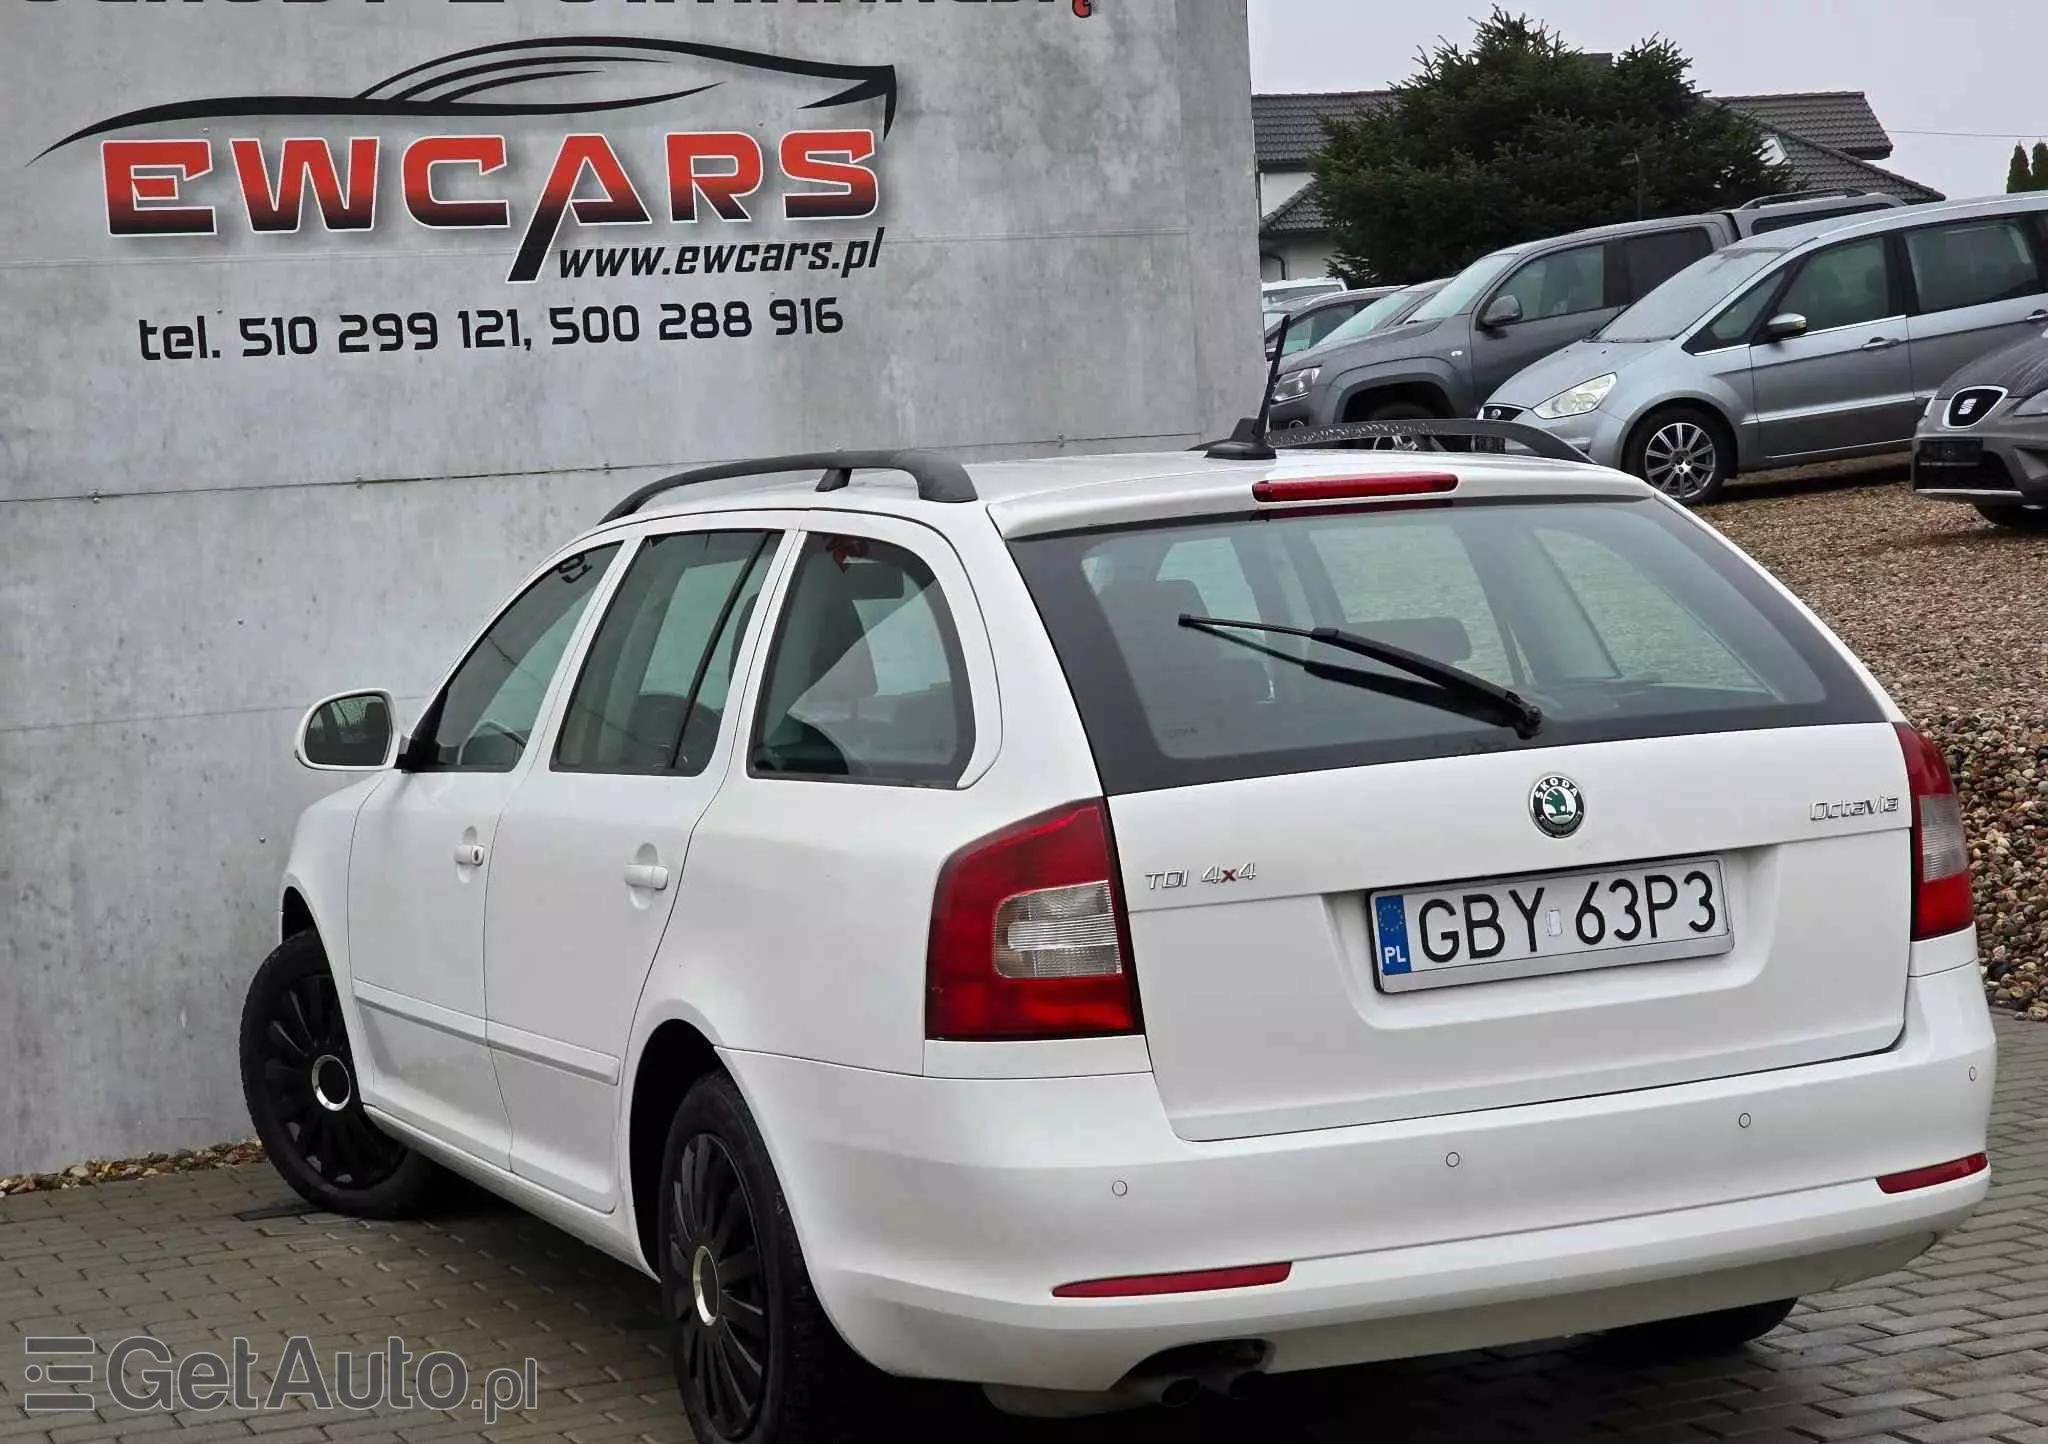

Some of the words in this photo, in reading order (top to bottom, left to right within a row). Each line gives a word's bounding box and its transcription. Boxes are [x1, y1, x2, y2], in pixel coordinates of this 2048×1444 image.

[102, 129, 878, 283] EWCARS
[560, 226, 886, 279] www.ewcars.pl
[138, 315, 221, 361] tel.
[239, 315, 318, 357] 510
[338, 311, 438, 354] 299
[457, 308, 532, 352] 121,
[549, 304, 640, 346] 500
[659, 300, 753, 341] 288
[769, 296, 844, 336] 916
[1809, 793, 1899, 821] Octavia
[1144, 869, 1190, 890] TDI
[1200, 861, 1257, 884] 4x4
[1418, 886, 1546, 963] GBY
[1575, 870, 1716, 946] 63P3
[1384, 946, 1407, 965] PL
